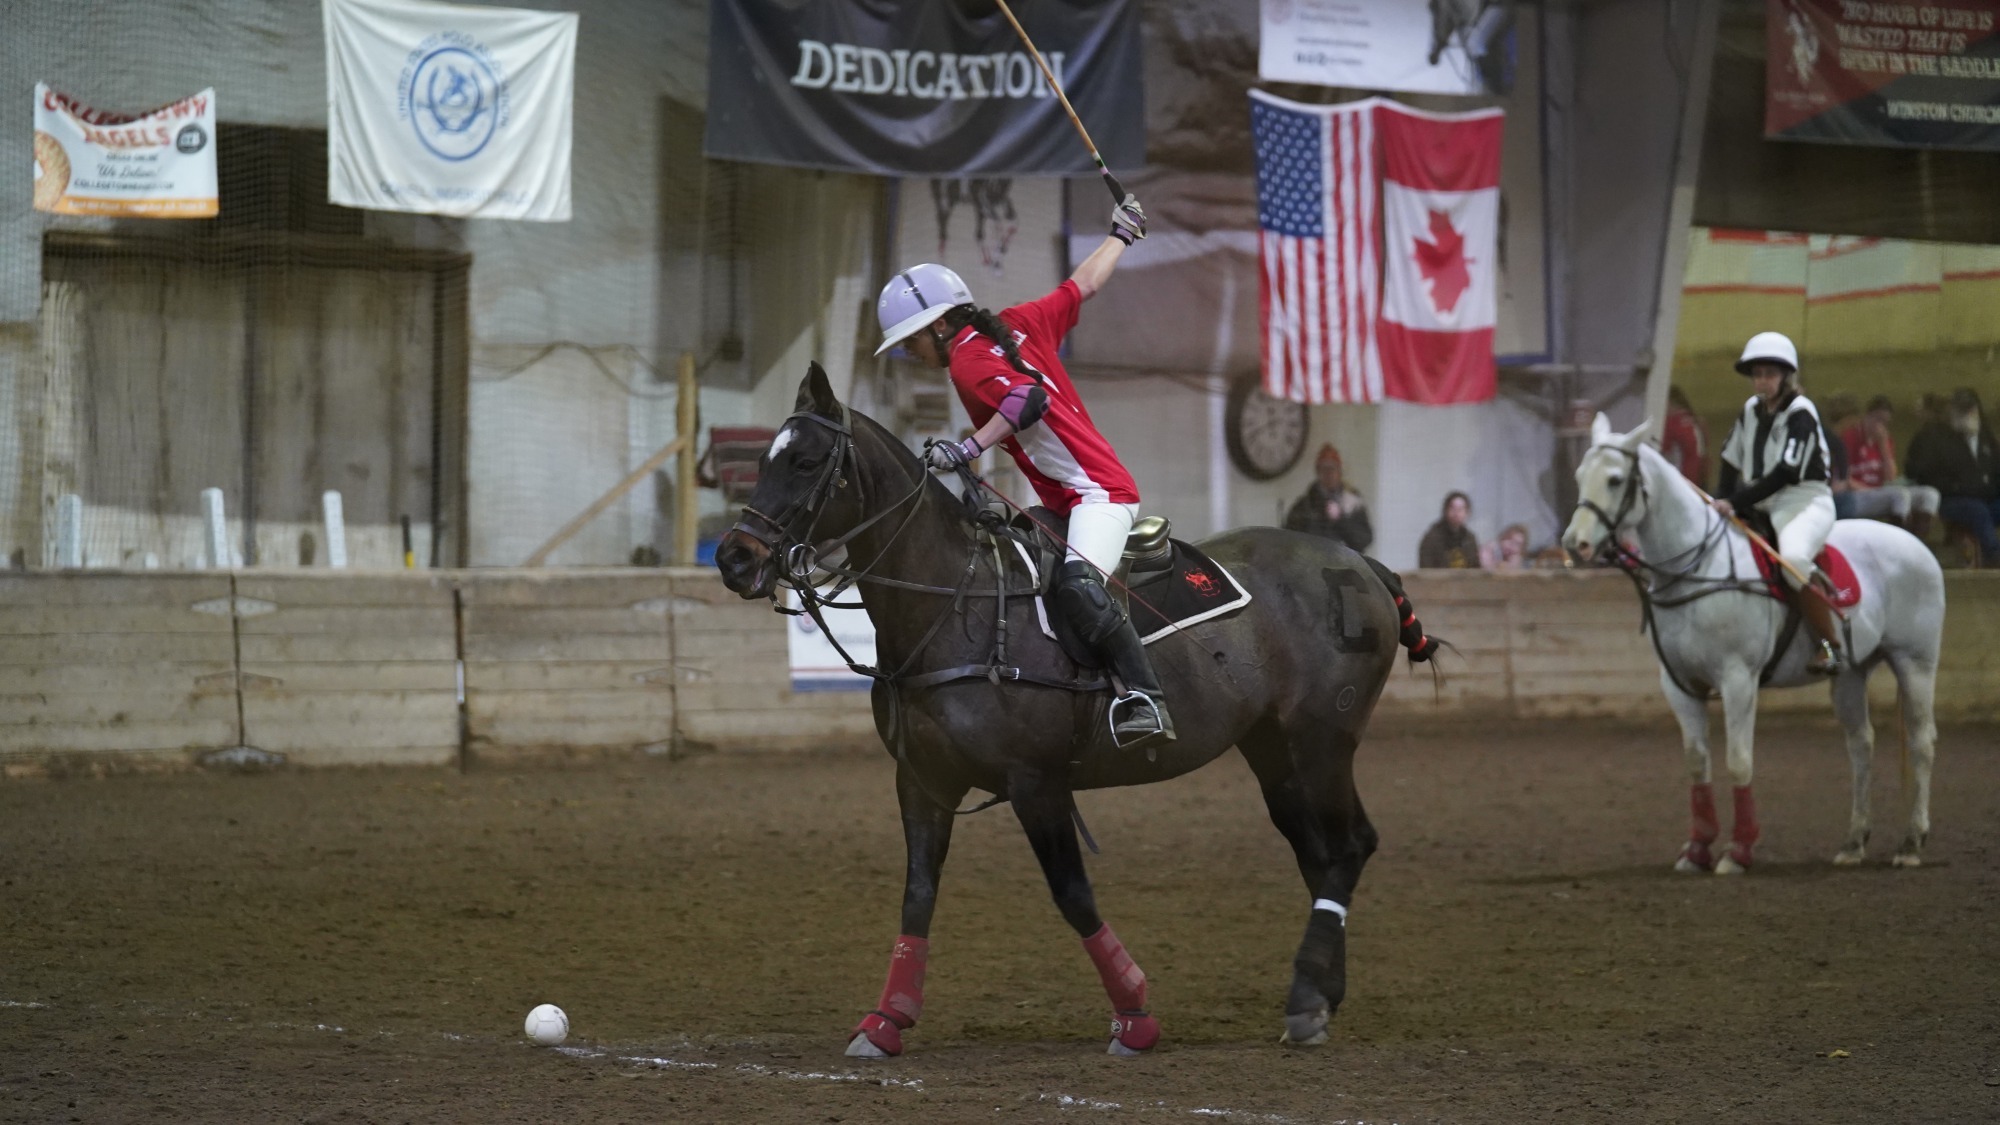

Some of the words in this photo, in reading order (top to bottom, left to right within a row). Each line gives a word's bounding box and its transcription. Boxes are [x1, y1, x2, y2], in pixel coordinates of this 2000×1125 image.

[1872, 4, 1918, 26] HOUR
[1919, 6, 1940, 27] OF
[1943, 8, 1975, 29] LIFE
[1977, 10, 1993, 31] IS
[1835, 24, 1905, 49] WASTED
[1907, 29, 1947, 51] THAT
[1949, 32, 1967, 54] IS
[790, 38, 1065, 99] DEDICATION
[1839, 48, 1886, 72] SPENT
[1888, 52, 1907, 74] IN
[1908, 54, 1937, 76] THE
[1887, 100, 1947, 121] WINSTON
